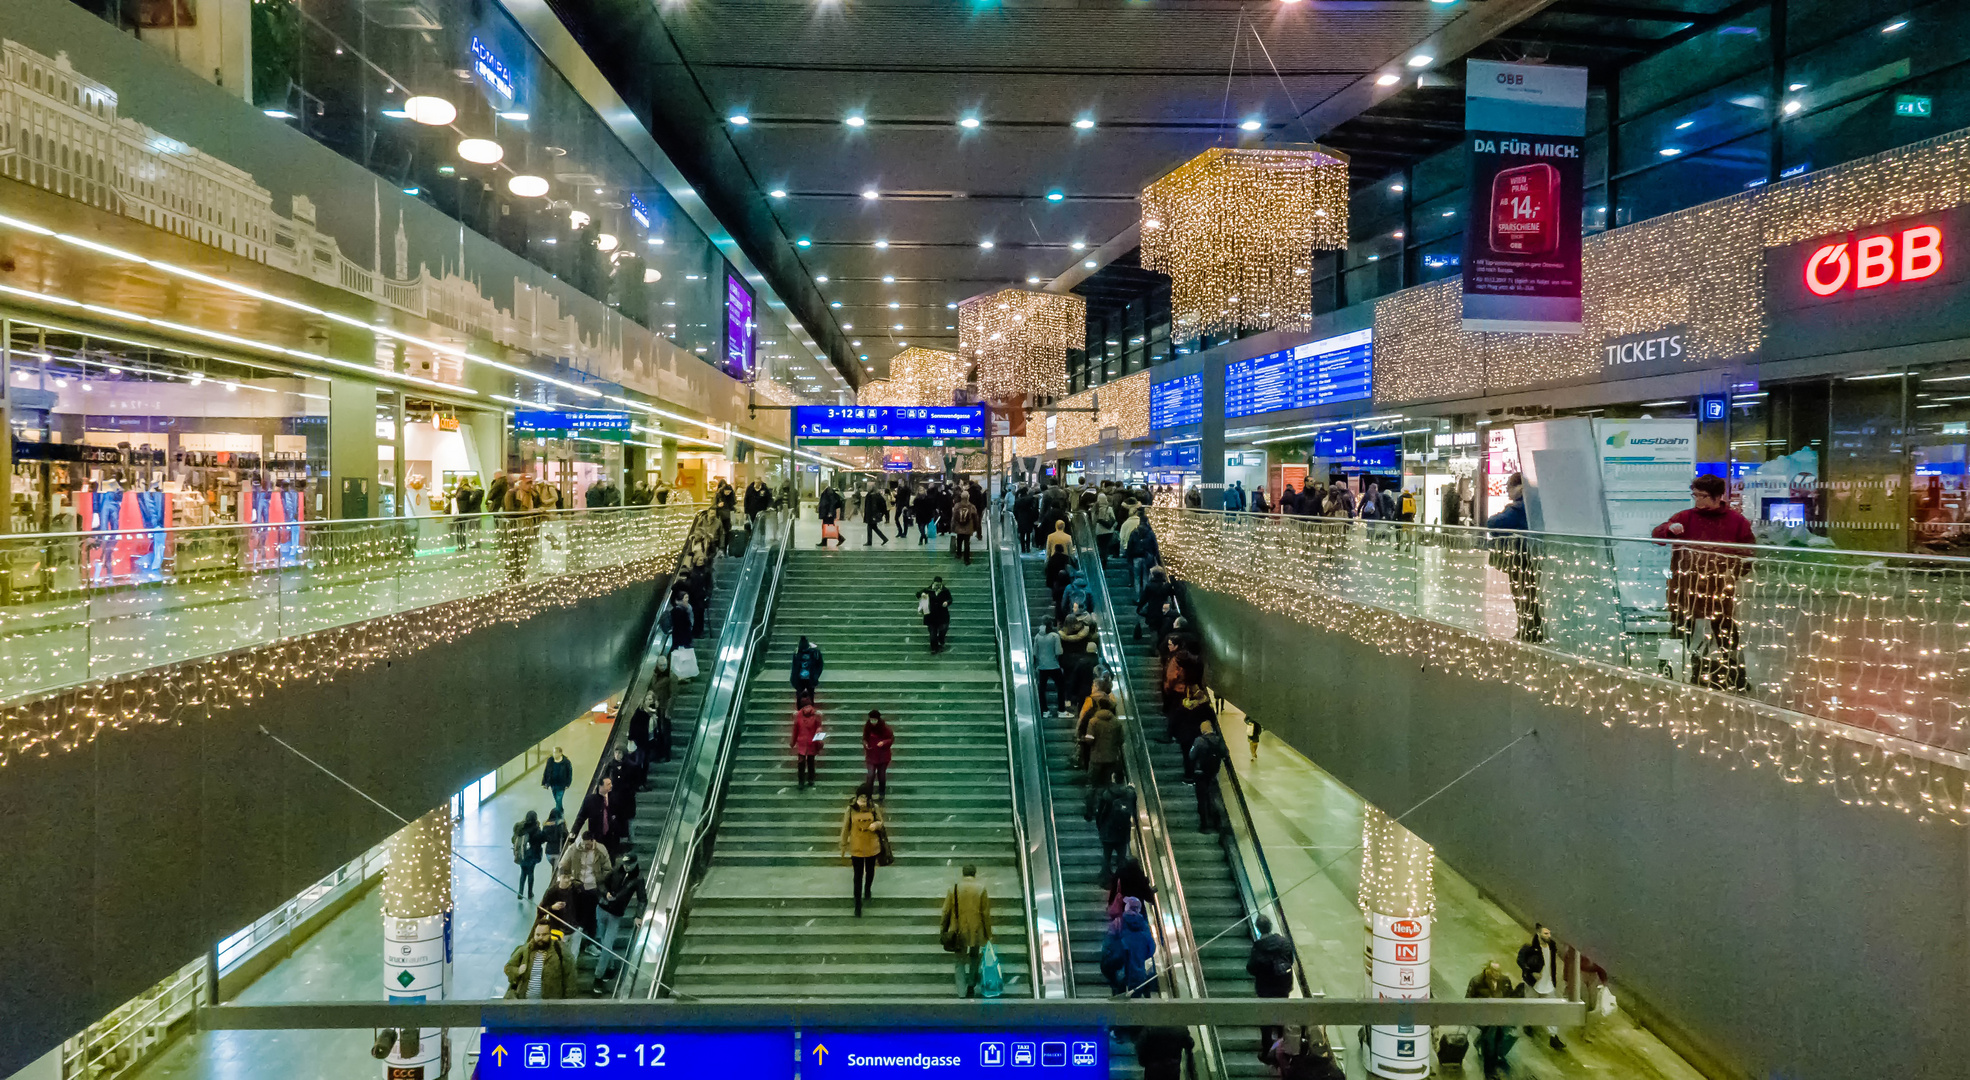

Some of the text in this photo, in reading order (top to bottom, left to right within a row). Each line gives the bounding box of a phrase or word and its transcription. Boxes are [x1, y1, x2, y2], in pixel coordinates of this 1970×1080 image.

[471, 37, 514, 89] ADMIRAL
[1497, 73, 1523, 85] ÖBB
[1474, 139, 1579, 158] DA FÜR MICH:
[1805, 225, 1943, 297] ÖBB
[1605, 335, 1682, 366] TICKETS
[1630, 437, 1689, 445] westbahn
[1393, 921, 1421, 935] Hervis
[1397, 945, 1417, 957] IN
[847, 1053, 961, 1070] Sonnwendgasse
[393, 1069, 416, 1078] CCC
